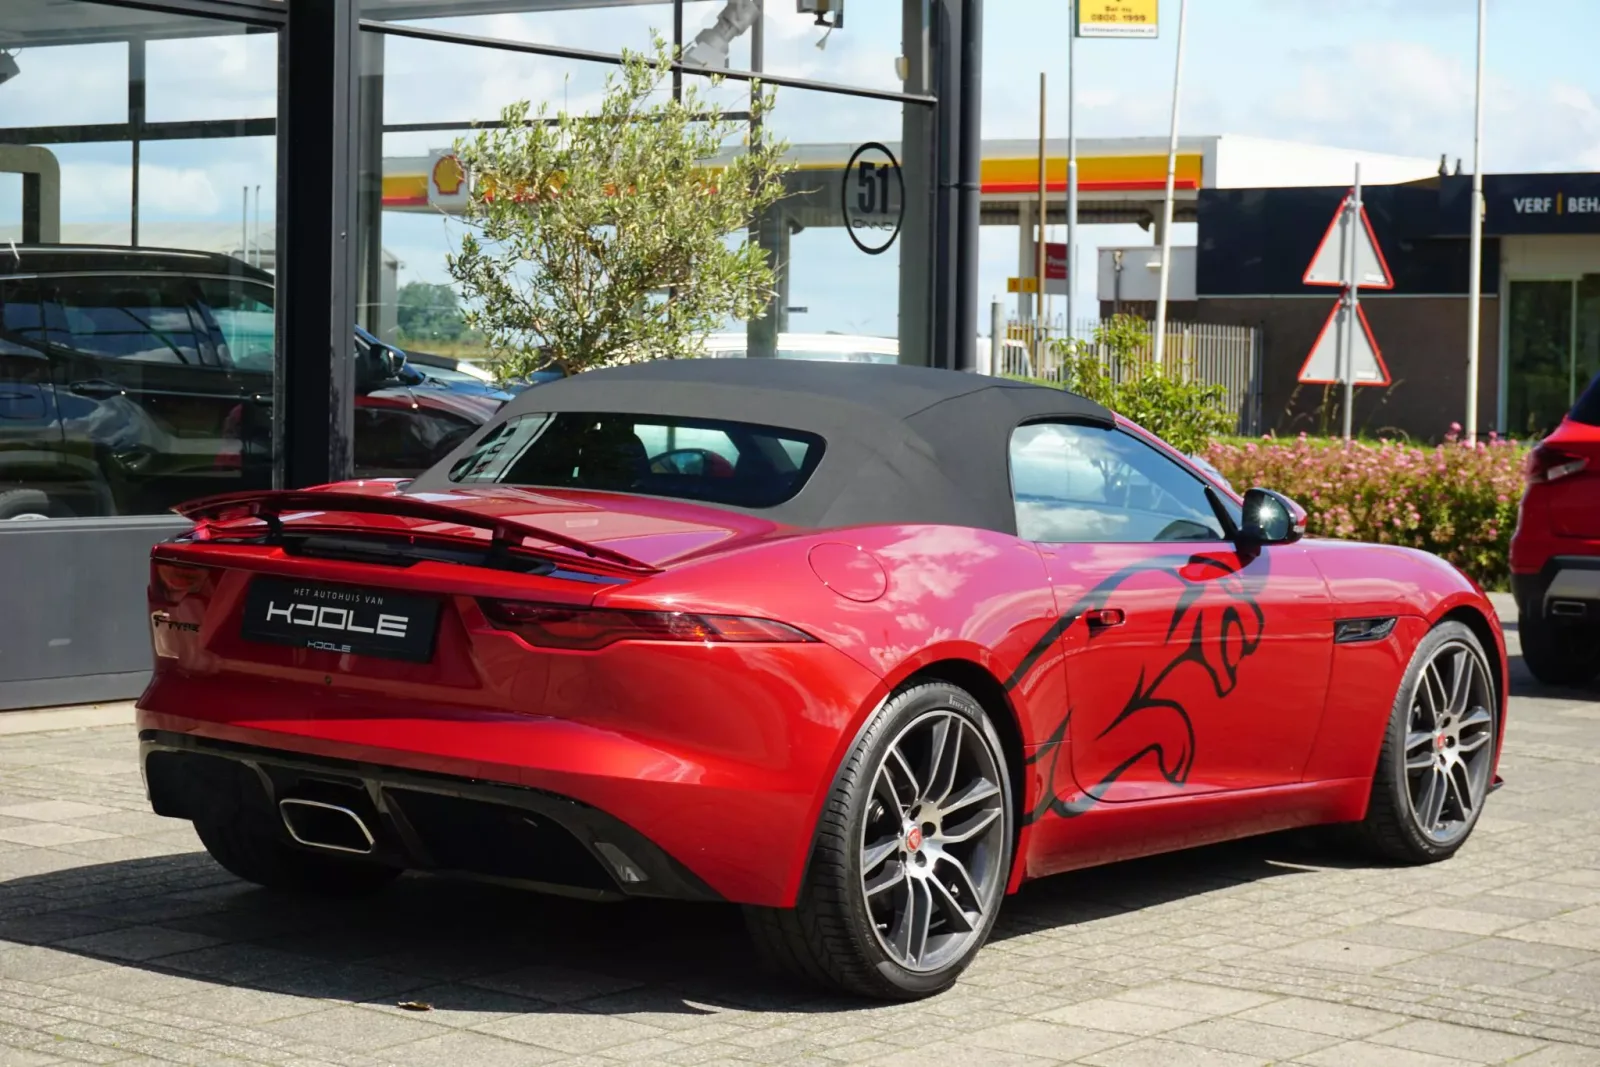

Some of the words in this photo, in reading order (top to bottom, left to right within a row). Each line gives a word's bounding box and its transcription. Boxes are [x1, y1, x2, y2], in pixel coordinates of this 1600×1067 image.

[858, 161, 889, 214] 51
[1513, 197, 1552, 213] VERF
[1567, 197, 1600, 213] BEH
[293, 588, 310, 597] HET
[314, 590, 361, 603] AUTOHUIS
[365, 596, 384, 605] VAN
